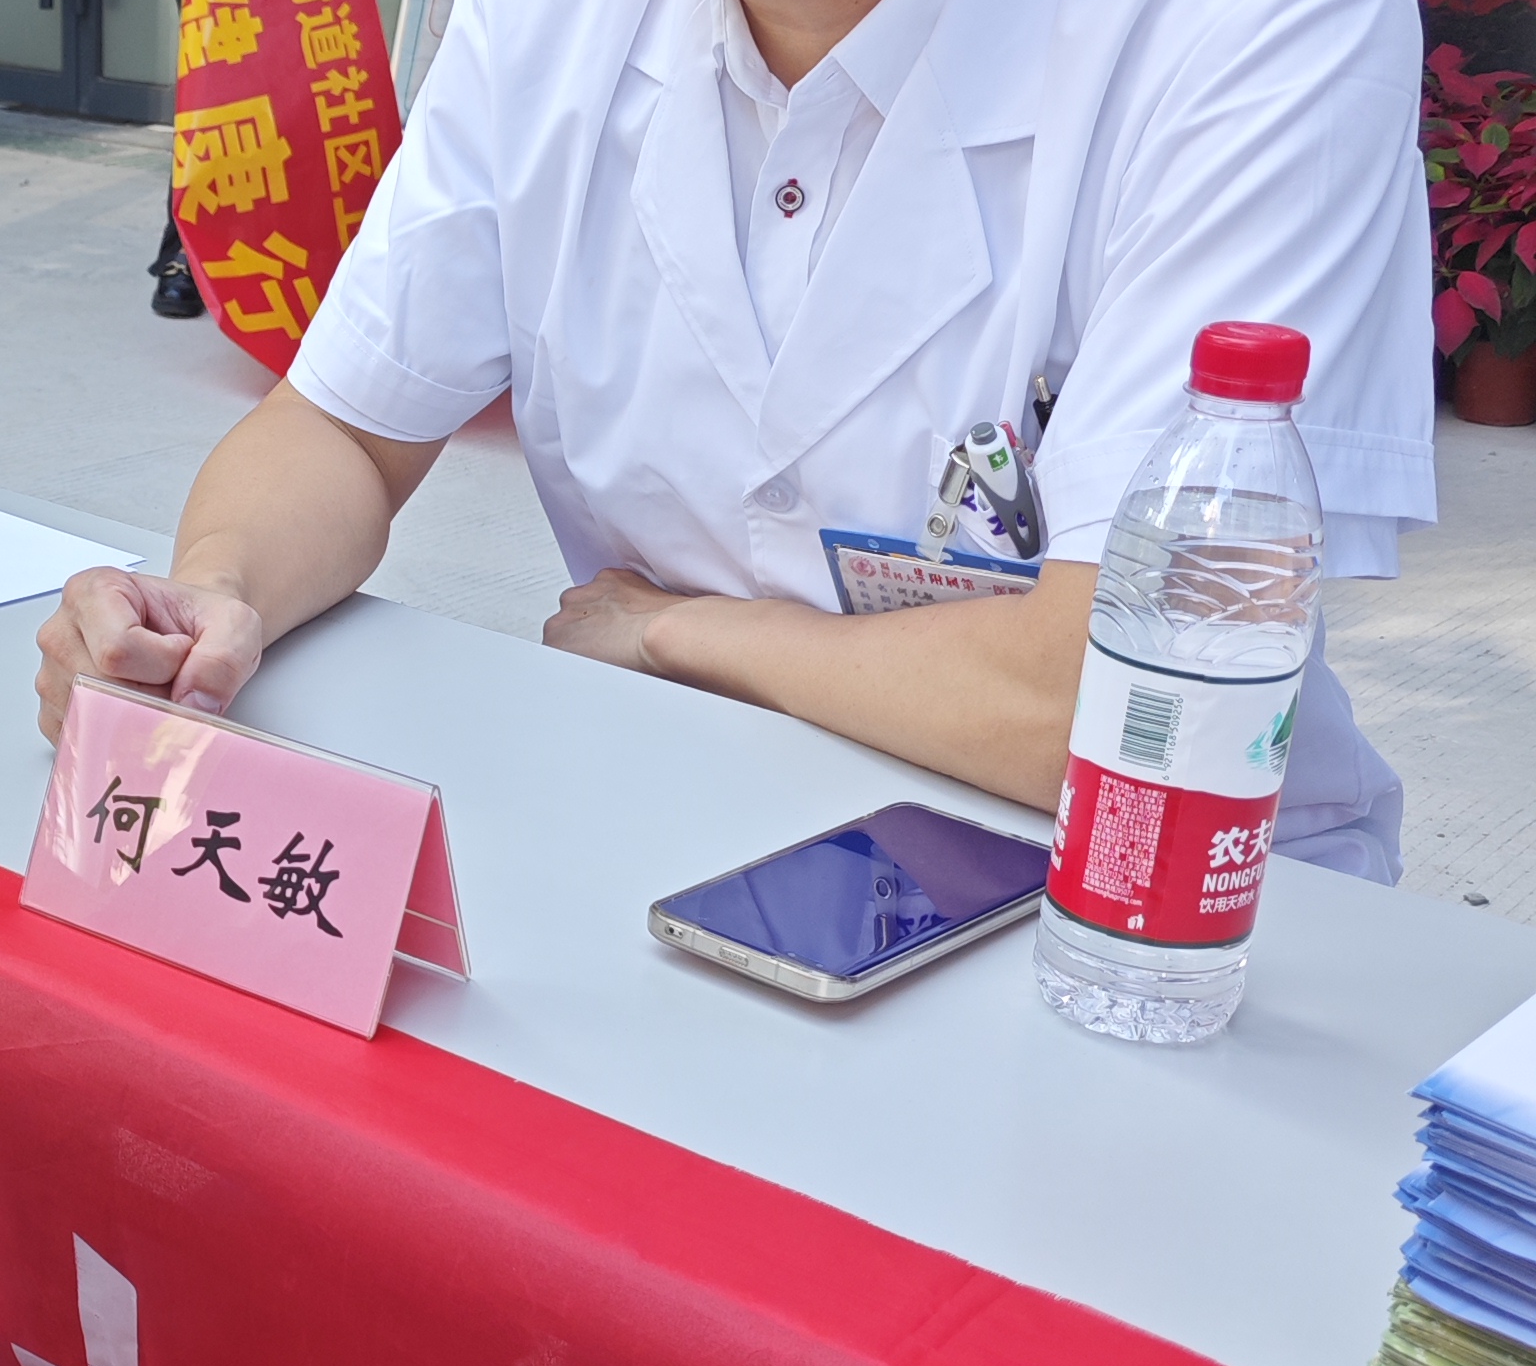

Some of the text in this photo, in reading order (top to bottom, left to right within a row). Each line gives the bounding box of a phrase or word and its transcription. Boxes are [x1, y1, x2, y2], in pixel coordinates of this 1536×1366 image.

[1170, 697, 1184, 734] 509256
[1163, 734, 1178, 769] 921168
[86, 776, 344, 939] 何天敏
